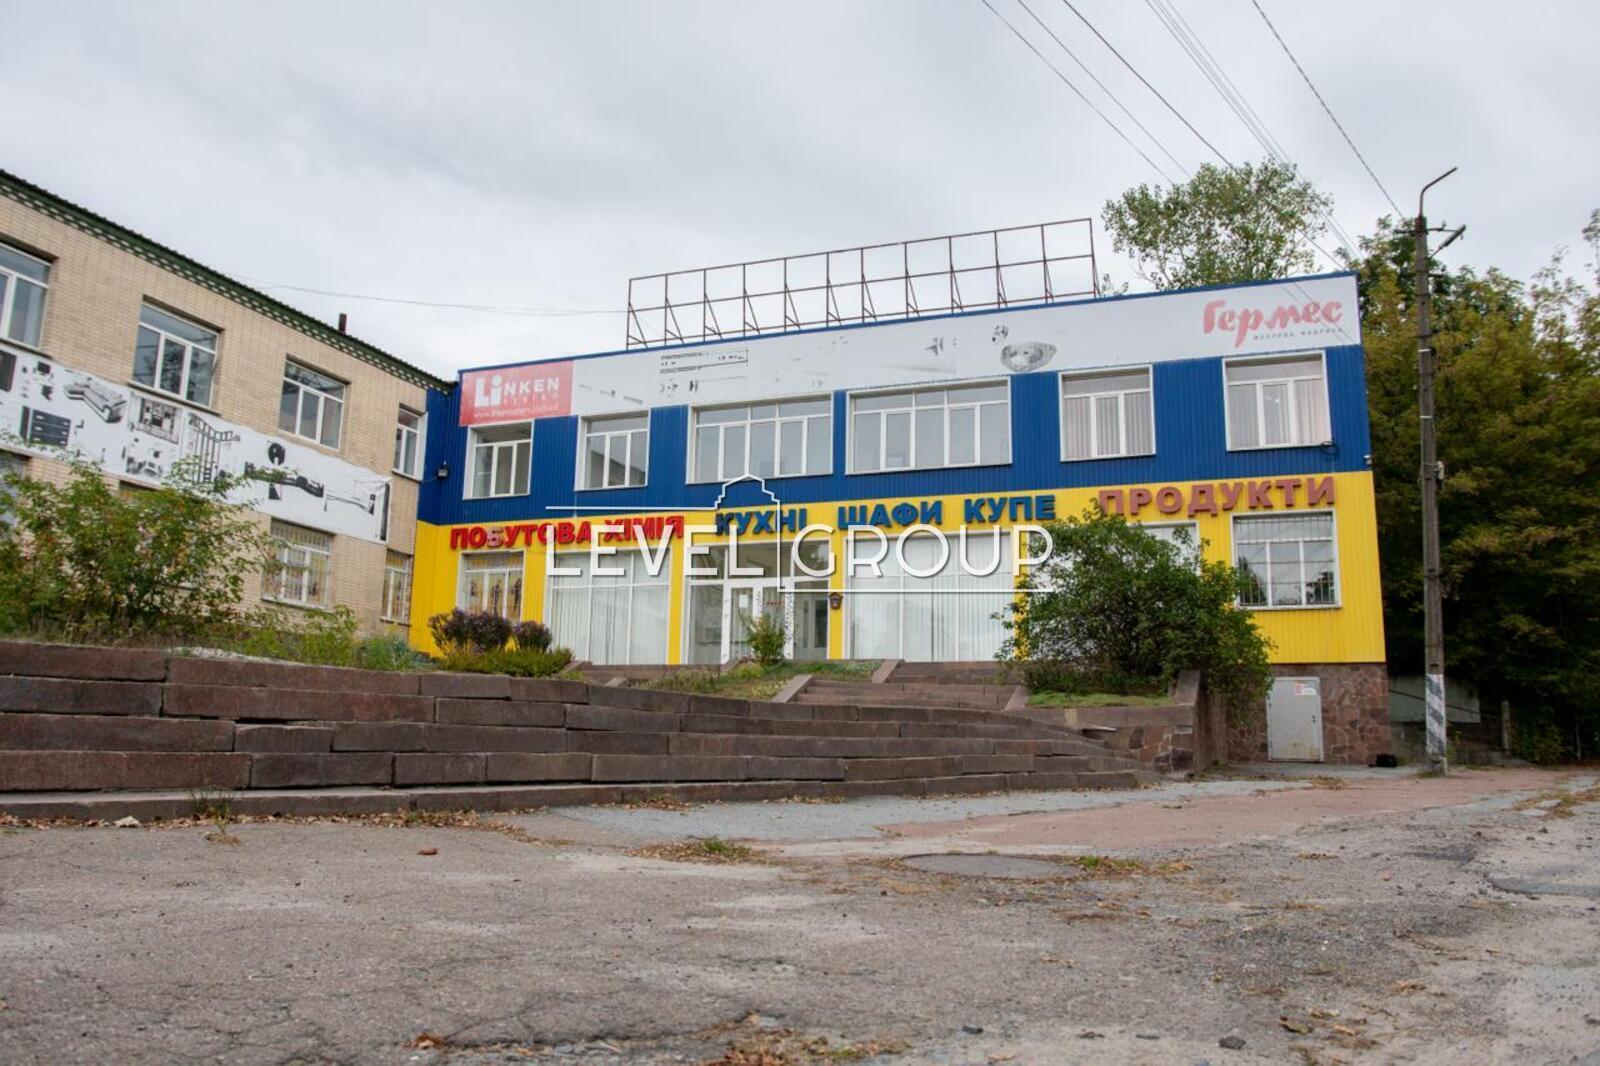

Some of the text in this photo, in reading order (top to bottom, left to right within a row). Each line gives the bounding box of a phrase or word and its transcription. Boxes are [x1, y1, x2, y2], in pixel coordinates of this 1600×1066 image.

[1203, 299, 1343, 348] Гермес
[715, 494, 1056, 536] КУХНІ ШАФИ КУПЕ
[1098, 476, 1336, 517] ПРОДУКТИ
[450, 515, 684, 549] ПОБУТОВА ХІМІЯ
